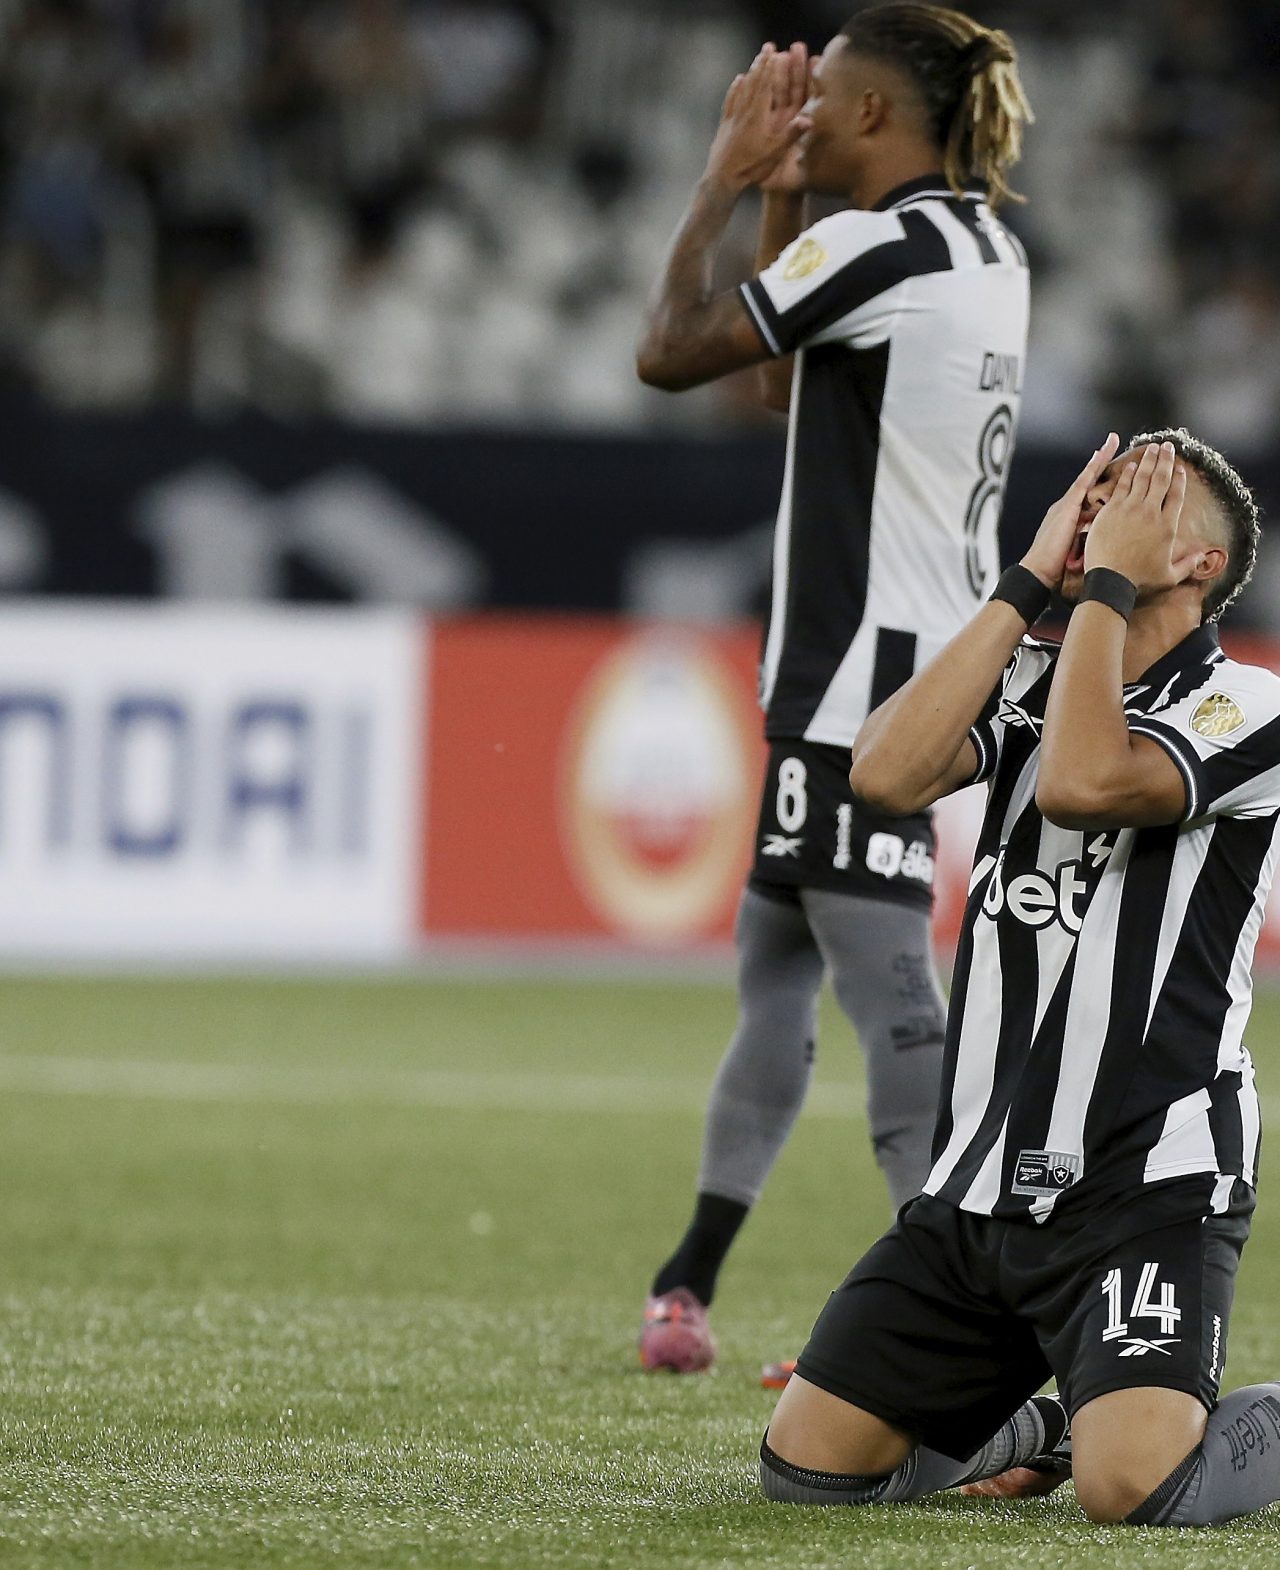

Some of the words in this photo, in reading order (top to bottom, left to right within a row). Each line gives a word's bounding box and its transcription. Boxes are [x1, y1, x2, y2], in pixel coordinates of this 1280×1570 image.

[776, 756, 808, 833] 8
[1101, 1262, 1182, 1342] 14
[1209, 1314, 1221, 1382] Reebok
